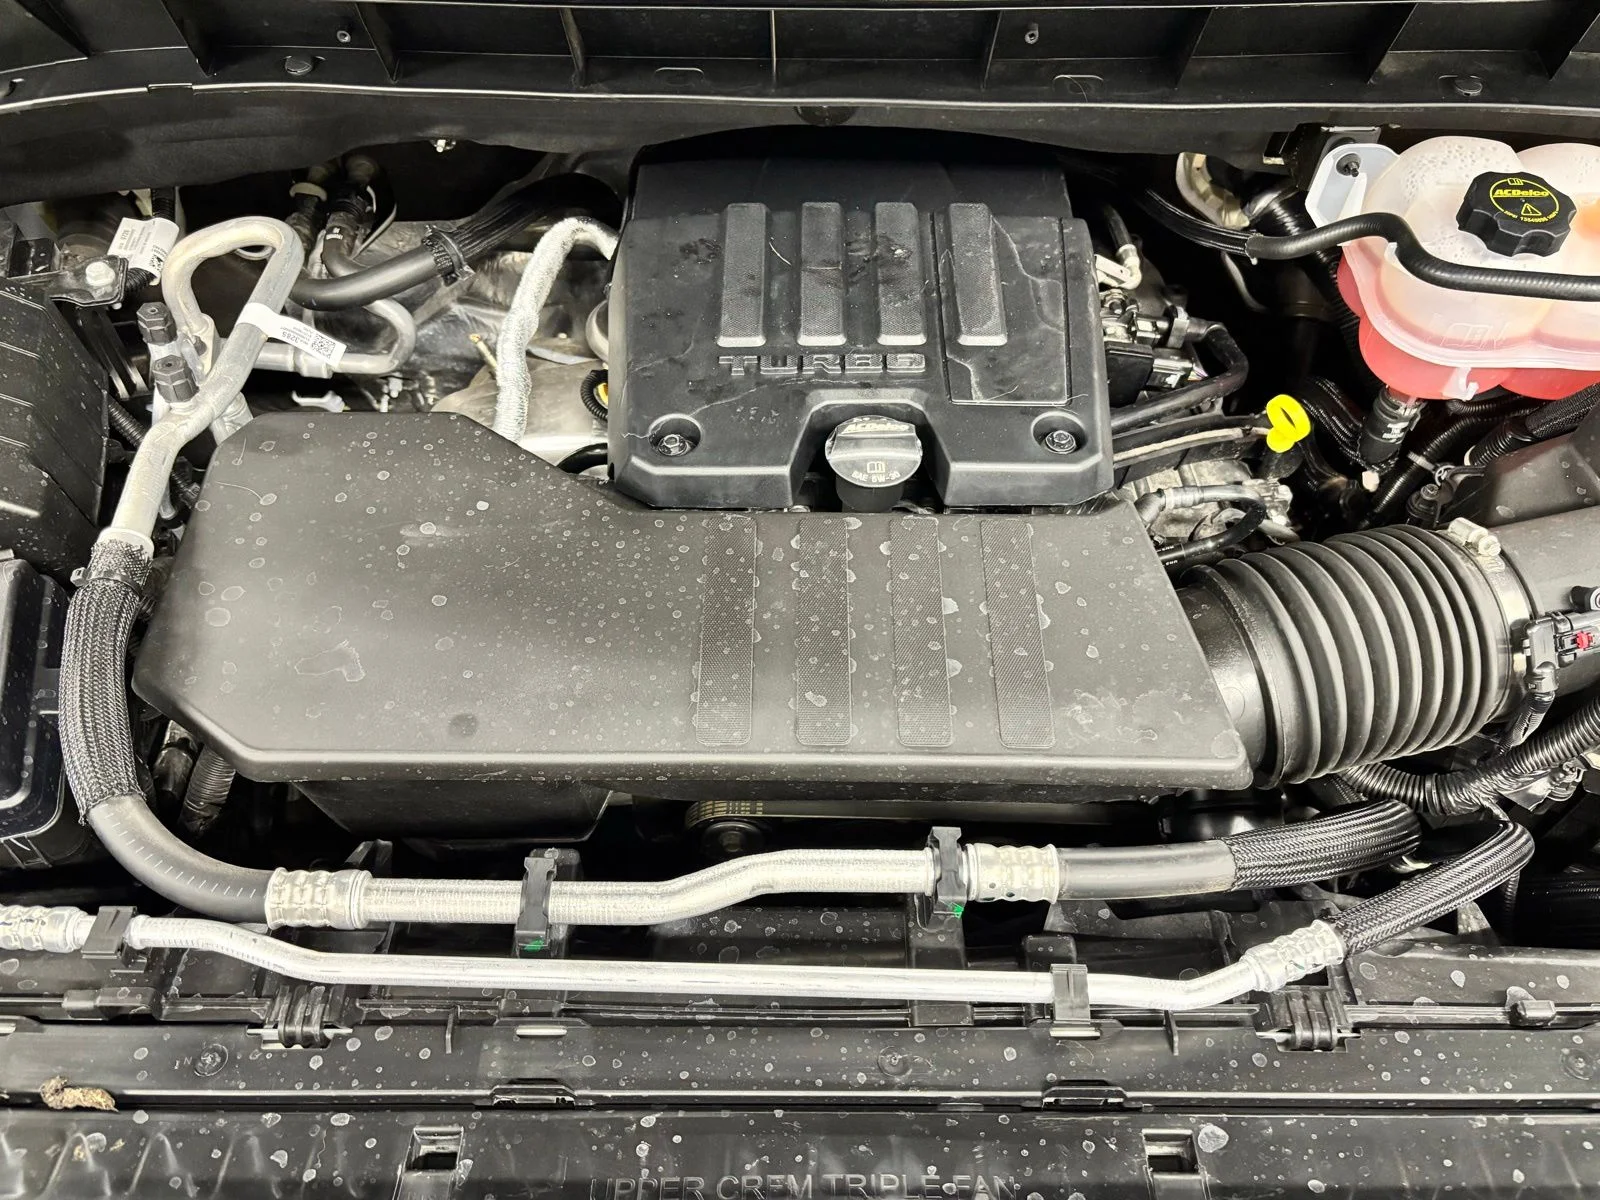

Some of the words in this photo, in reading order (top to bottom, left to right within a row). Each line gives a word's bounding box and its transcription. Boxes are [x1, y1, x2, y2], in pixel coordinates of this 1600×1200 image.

[1493, 188, 1550, 198] ACDelco
[718, 353, 926, 376] TURBO
[842, 422, 910, 433] ACDelco
[852, 470, 869, 482] SAE
[590, 1176, 705, 1200] UPPER
[822, 1173, 942, 1200] TRIPLE
[952, 1175, 1016, 1200] FAN
